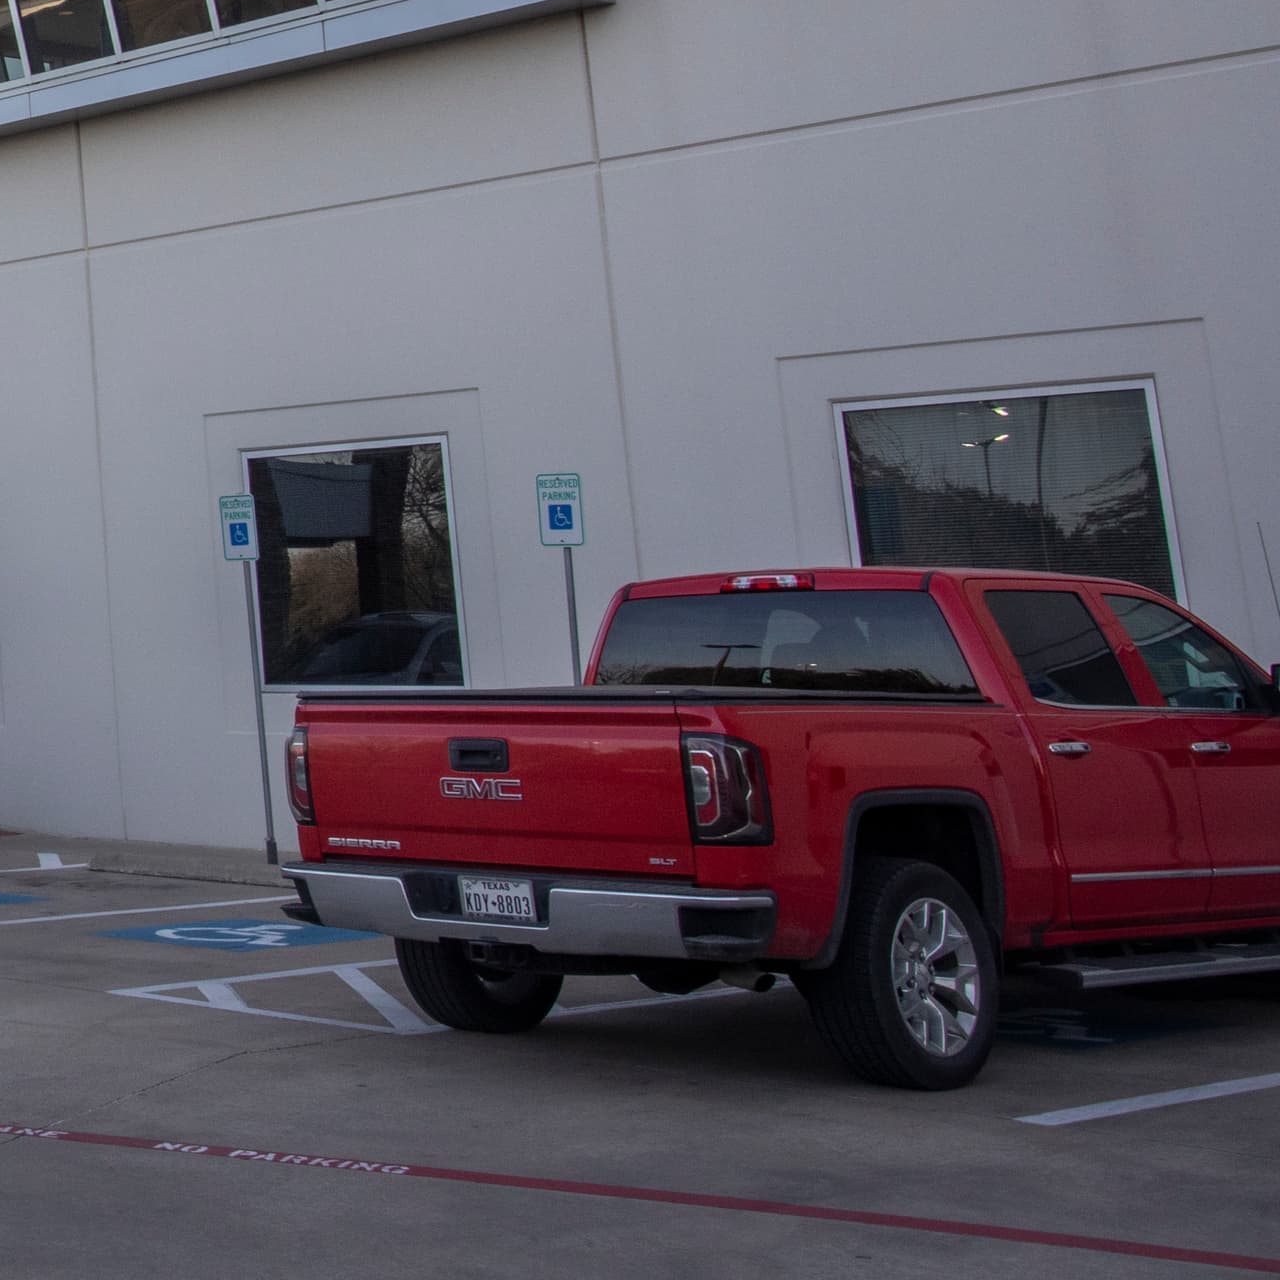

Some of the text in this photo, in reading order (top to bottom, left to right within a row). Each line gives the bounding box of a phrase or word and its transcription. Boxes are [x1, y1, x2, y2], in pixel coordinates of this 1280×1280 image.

[539, 479, 578, 489] RESERVED
[542, 491, 576, 500] PARKING
[440, 776, 523, 801] GMC
[328, 837, 401, 850] SIERRA
[649, 857, 677, 866] SLT
[481, 881, 511, 891] TEXAS
[153, 1142, 410, 1175] NO PARKING
